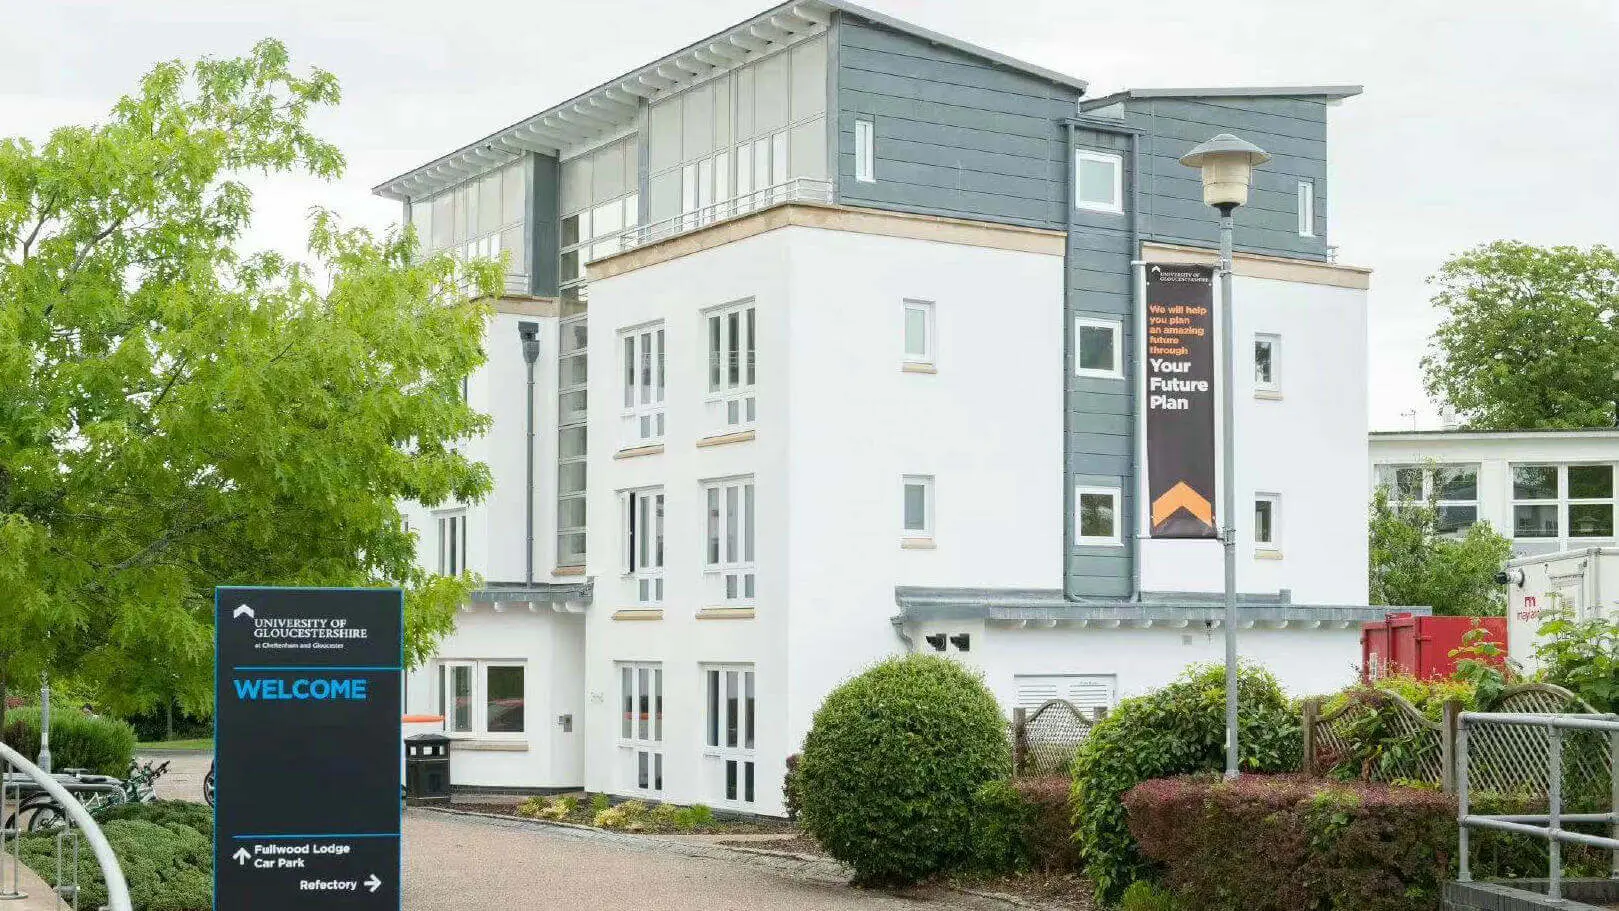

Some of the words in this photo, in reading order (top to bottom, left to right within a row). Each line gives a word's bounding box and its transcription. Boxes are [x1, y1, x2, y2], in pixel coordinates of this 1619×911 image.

[1149, 304, 1166, 314] We
[1168, 306, 1184, 314] will
[1186, 306, 1208, 316] help
[1150, 317, 1168, 326] you
[1170, 316, 1190, 325] plan
[1163, 326, 1204, 336] amazing
[1150, 336, 1180, 344] future
[1150, 346, 1188, 356] through
[1150, 358, 1191, 373] Your
[1150, 378, 1208, 392] Future
[1151, 396, 1188, 410] Plan
[254, 619, 328, 628] UNIVERSITY
[330, 619, 346, 628] OF
[254, 628, 368, 638] GLOUCESTERSHIRE
[233, 679, 367, 700] WELCOME
[254, 844, 310, 854] Fullwood
[313, 844, 350, 854] Lodge
[254, 858, 276, 868] Car
[278, 857, 305, 868] Park
[300, 880, 358, 892] Refectory
